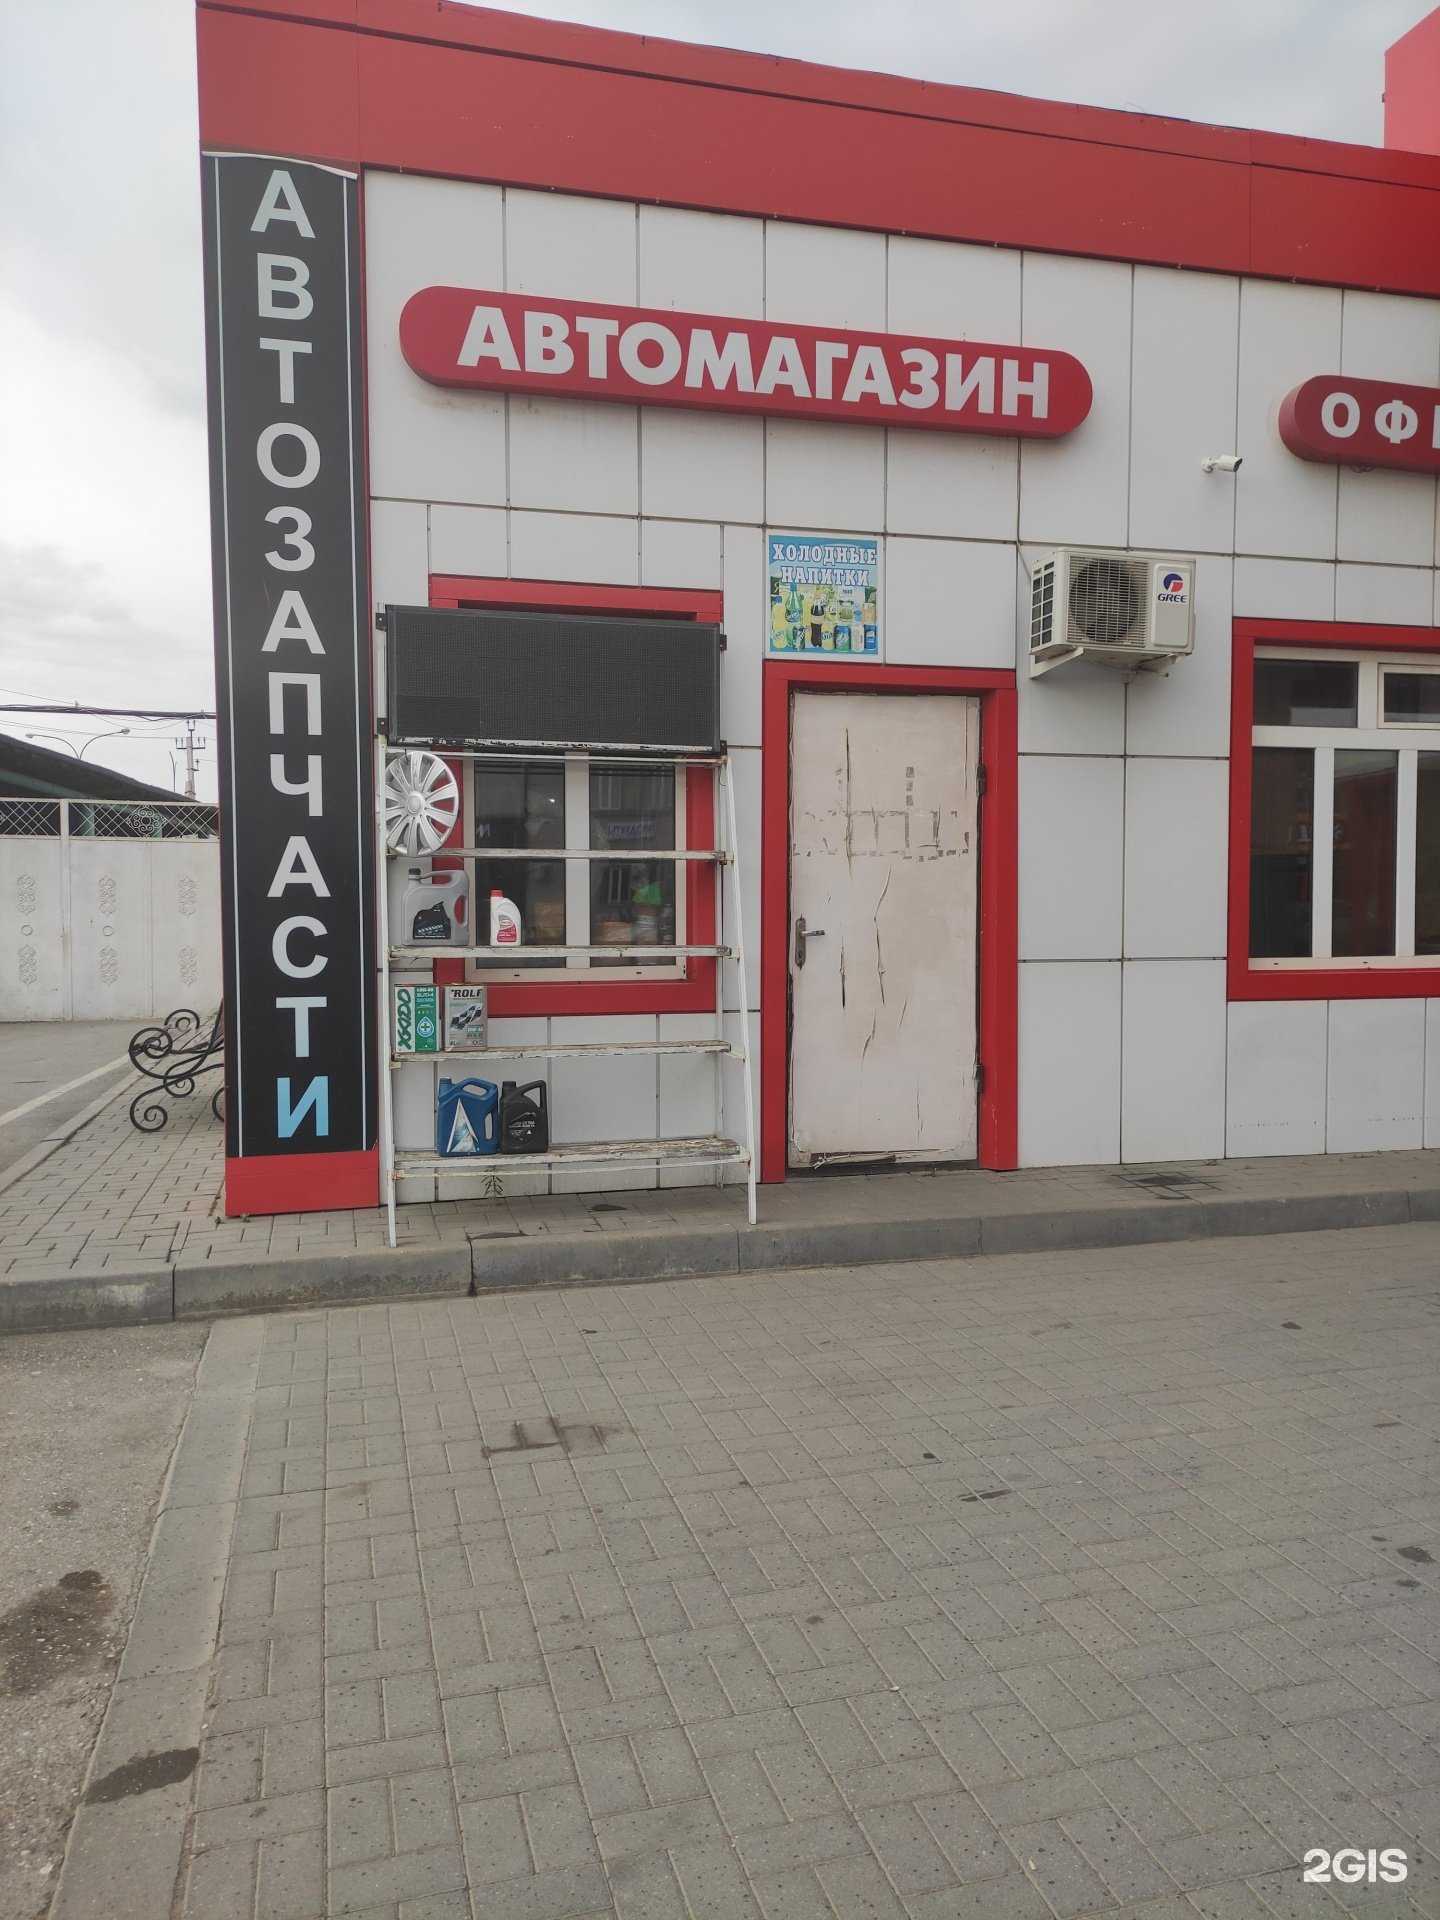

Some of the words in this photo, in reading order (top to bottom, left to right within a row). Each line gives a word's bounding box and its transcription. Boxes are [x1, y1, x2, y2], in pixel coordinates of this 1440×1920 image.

[457, 305, 1049, 419] АВТОМАГАЗИН
[772, 543, 877, 566] ХОЛОДНЫЕ
[780, 566, 869, 586] НАПИТКИ
[1157, 593, 1188, 604] GREE
[250, 169, 332, 1139] АВТОЗАПЧАСТИ
